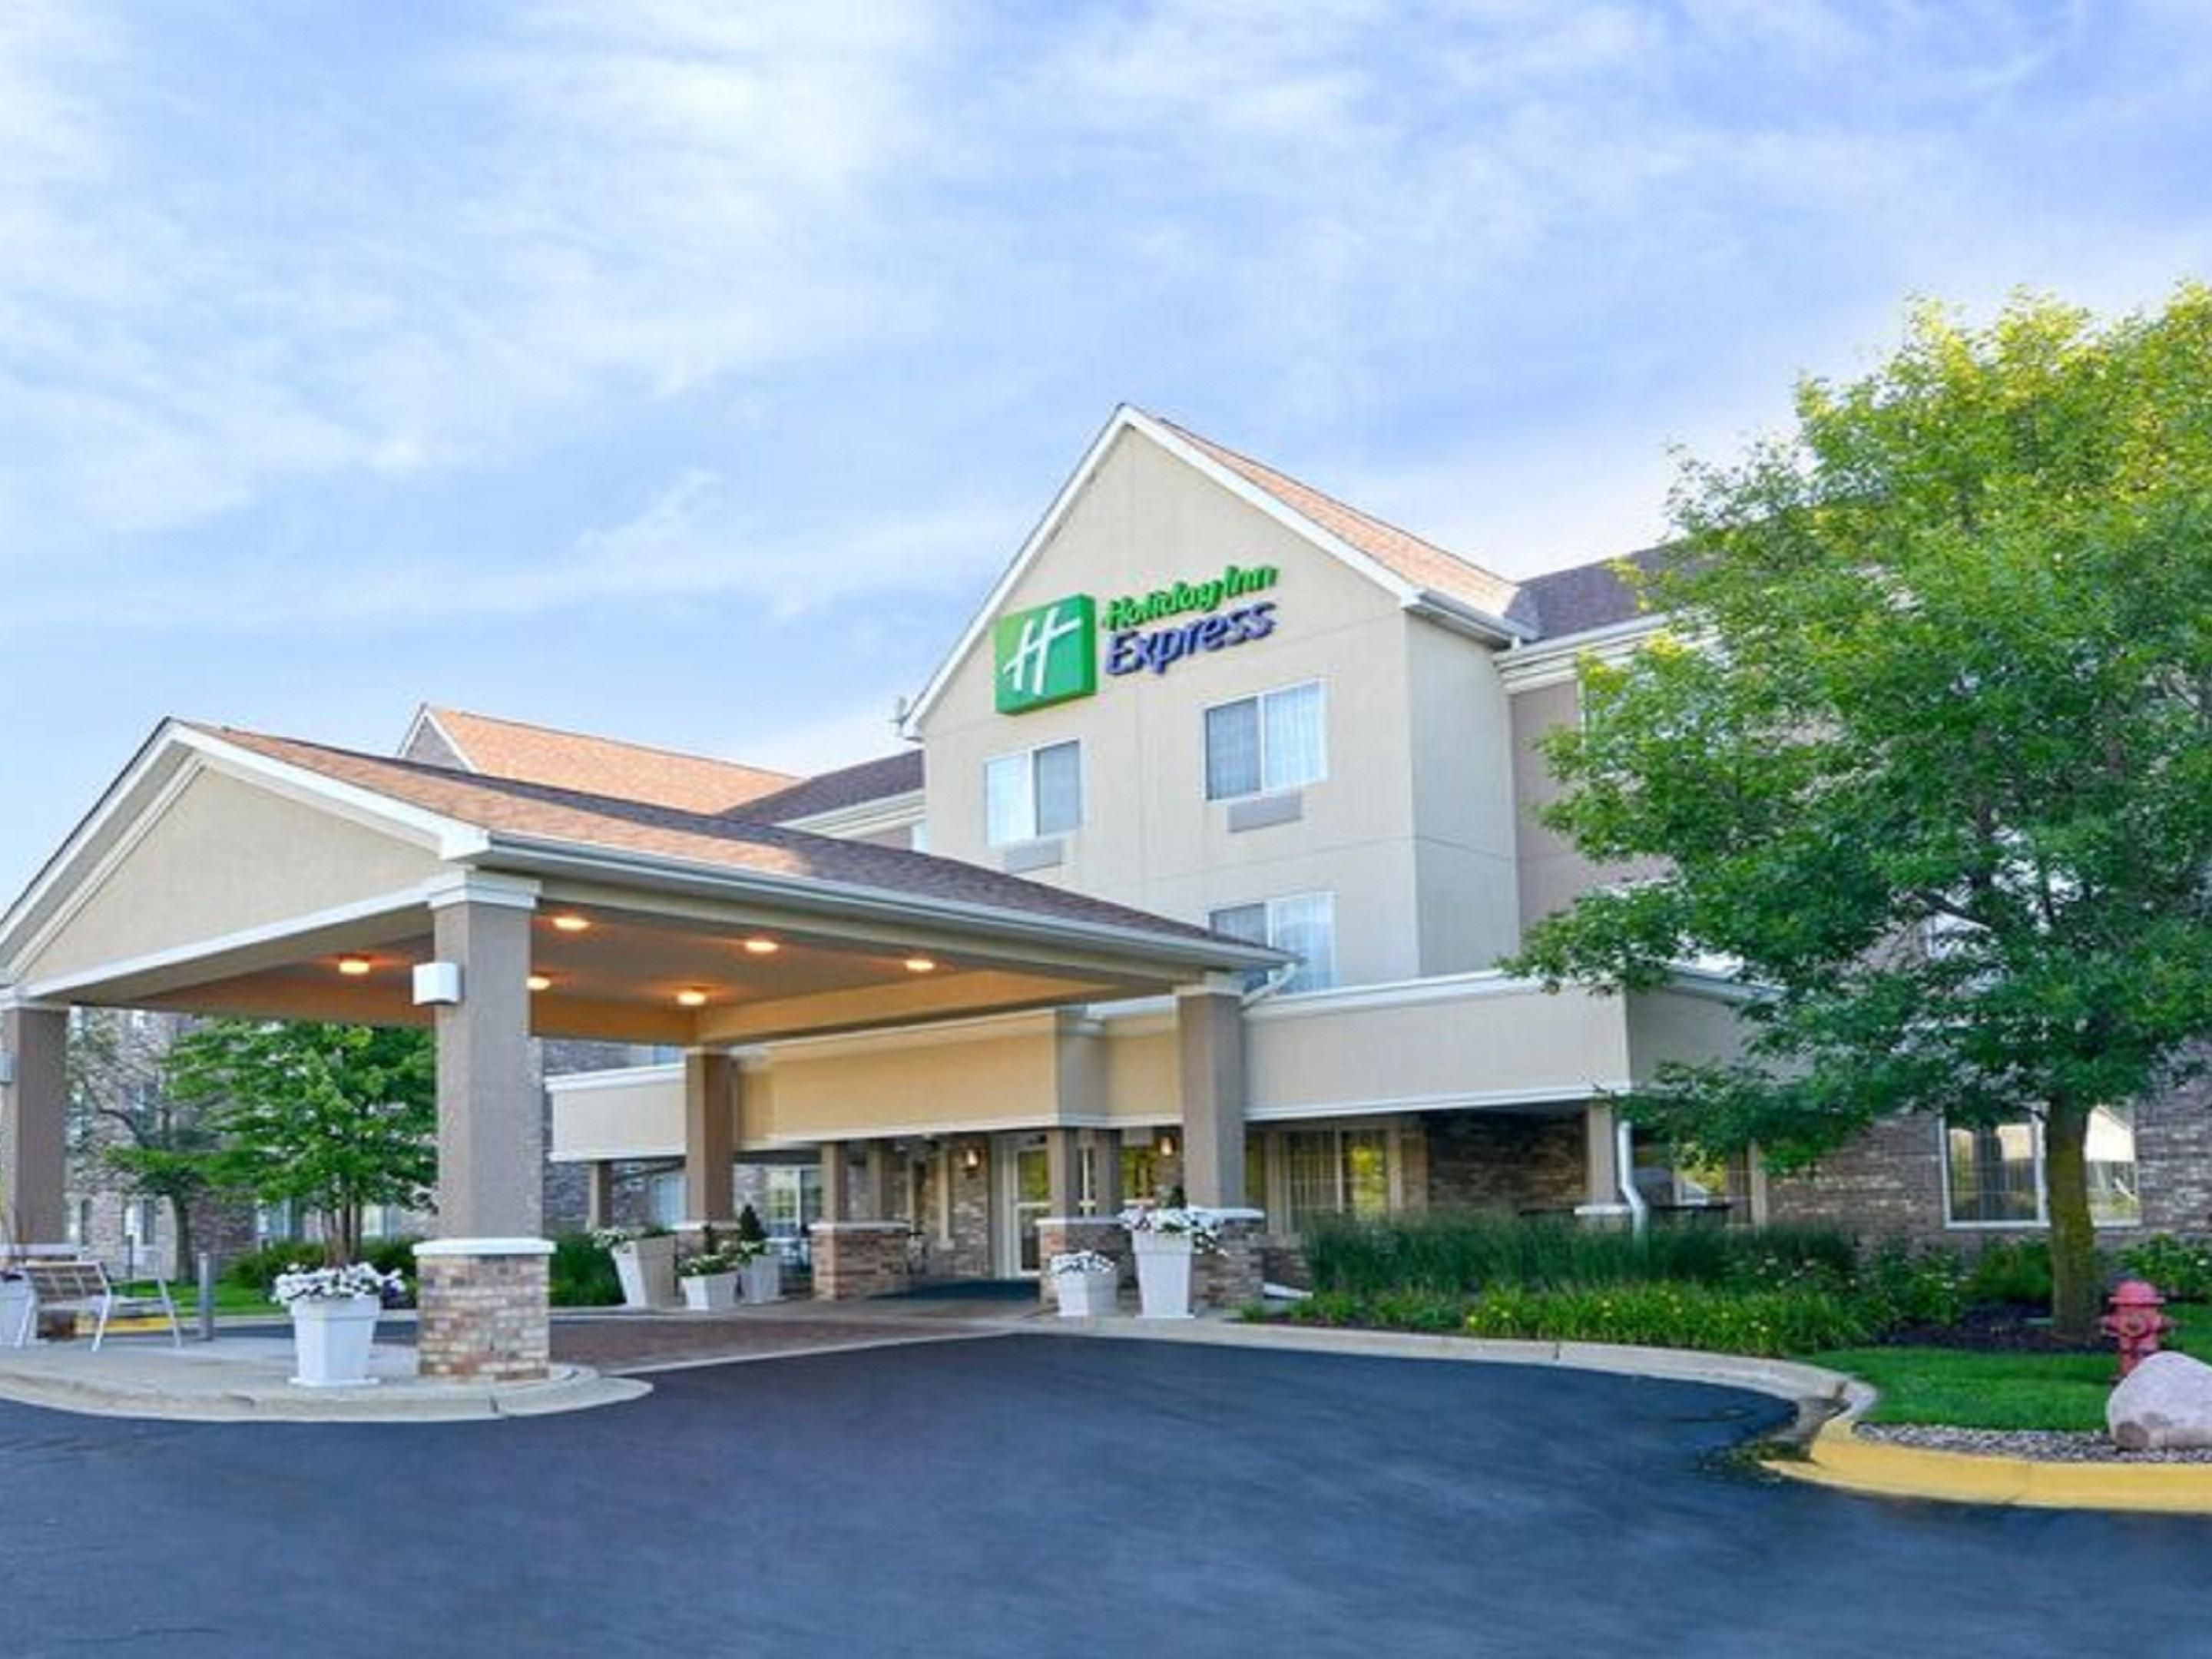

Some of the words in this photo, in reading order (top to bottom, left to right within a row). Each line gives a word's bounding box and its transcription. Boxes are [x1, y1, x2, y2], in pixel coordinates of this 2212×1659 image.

[1102, 581, 1223, 631] Holiday
[1223, 565, 1280, 598] Inn
[1106, 601, 1277, 676] Express
